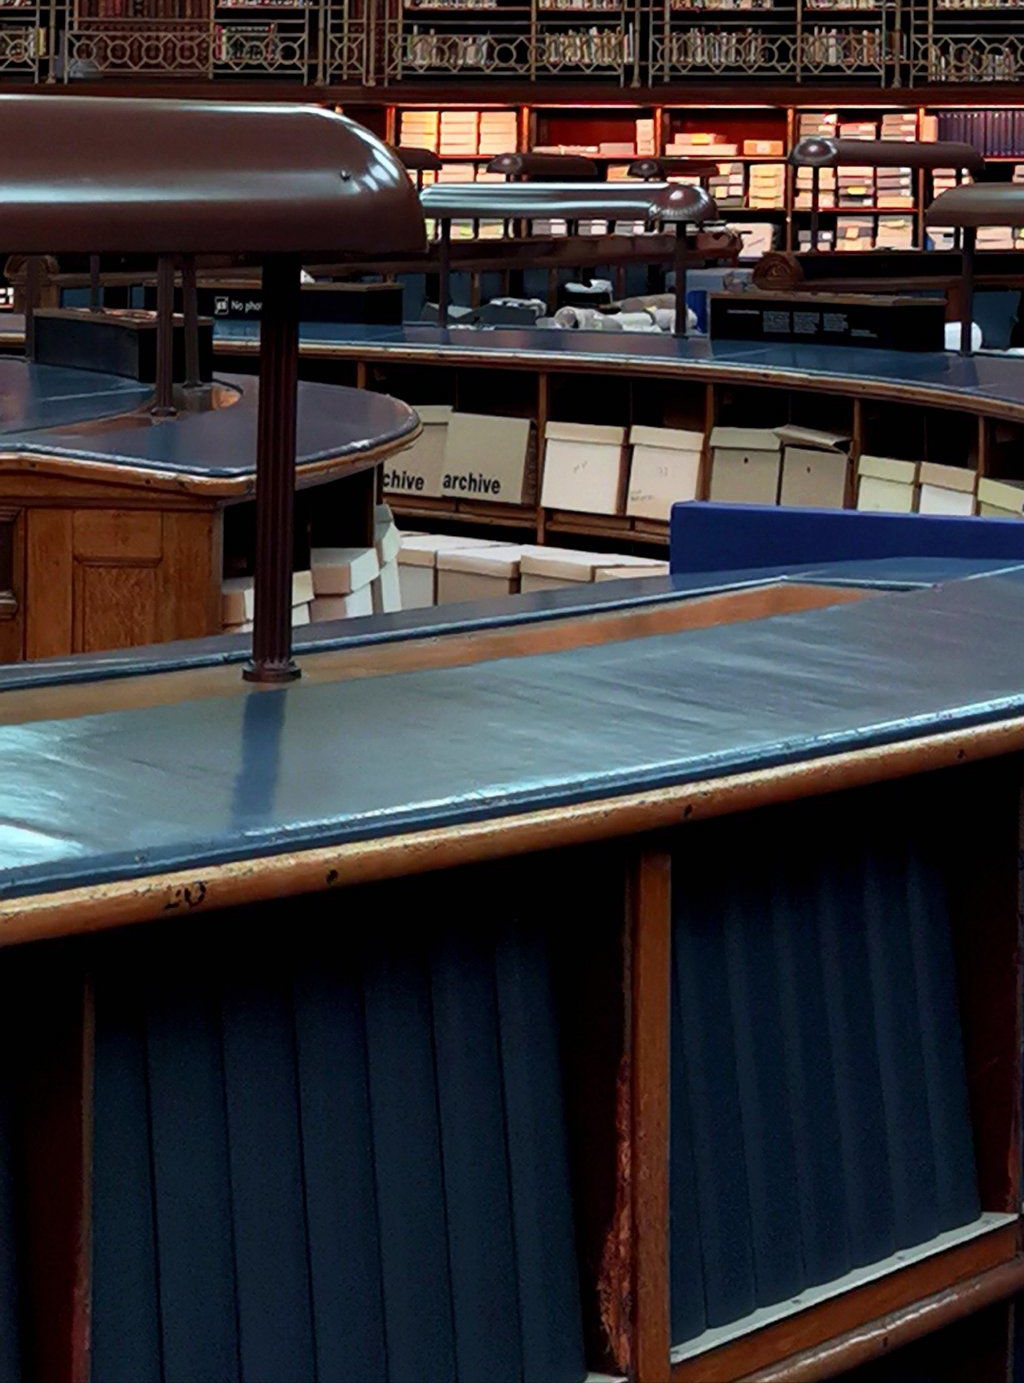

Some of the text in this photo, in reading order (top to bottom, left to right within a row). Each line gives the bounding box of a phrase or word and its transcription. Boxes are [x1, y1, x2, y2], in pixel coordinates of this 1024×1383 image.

[231, 300, 243, 311] No
[383, 470, 425, 491] chive
[442, 473, 501, 494] archive
